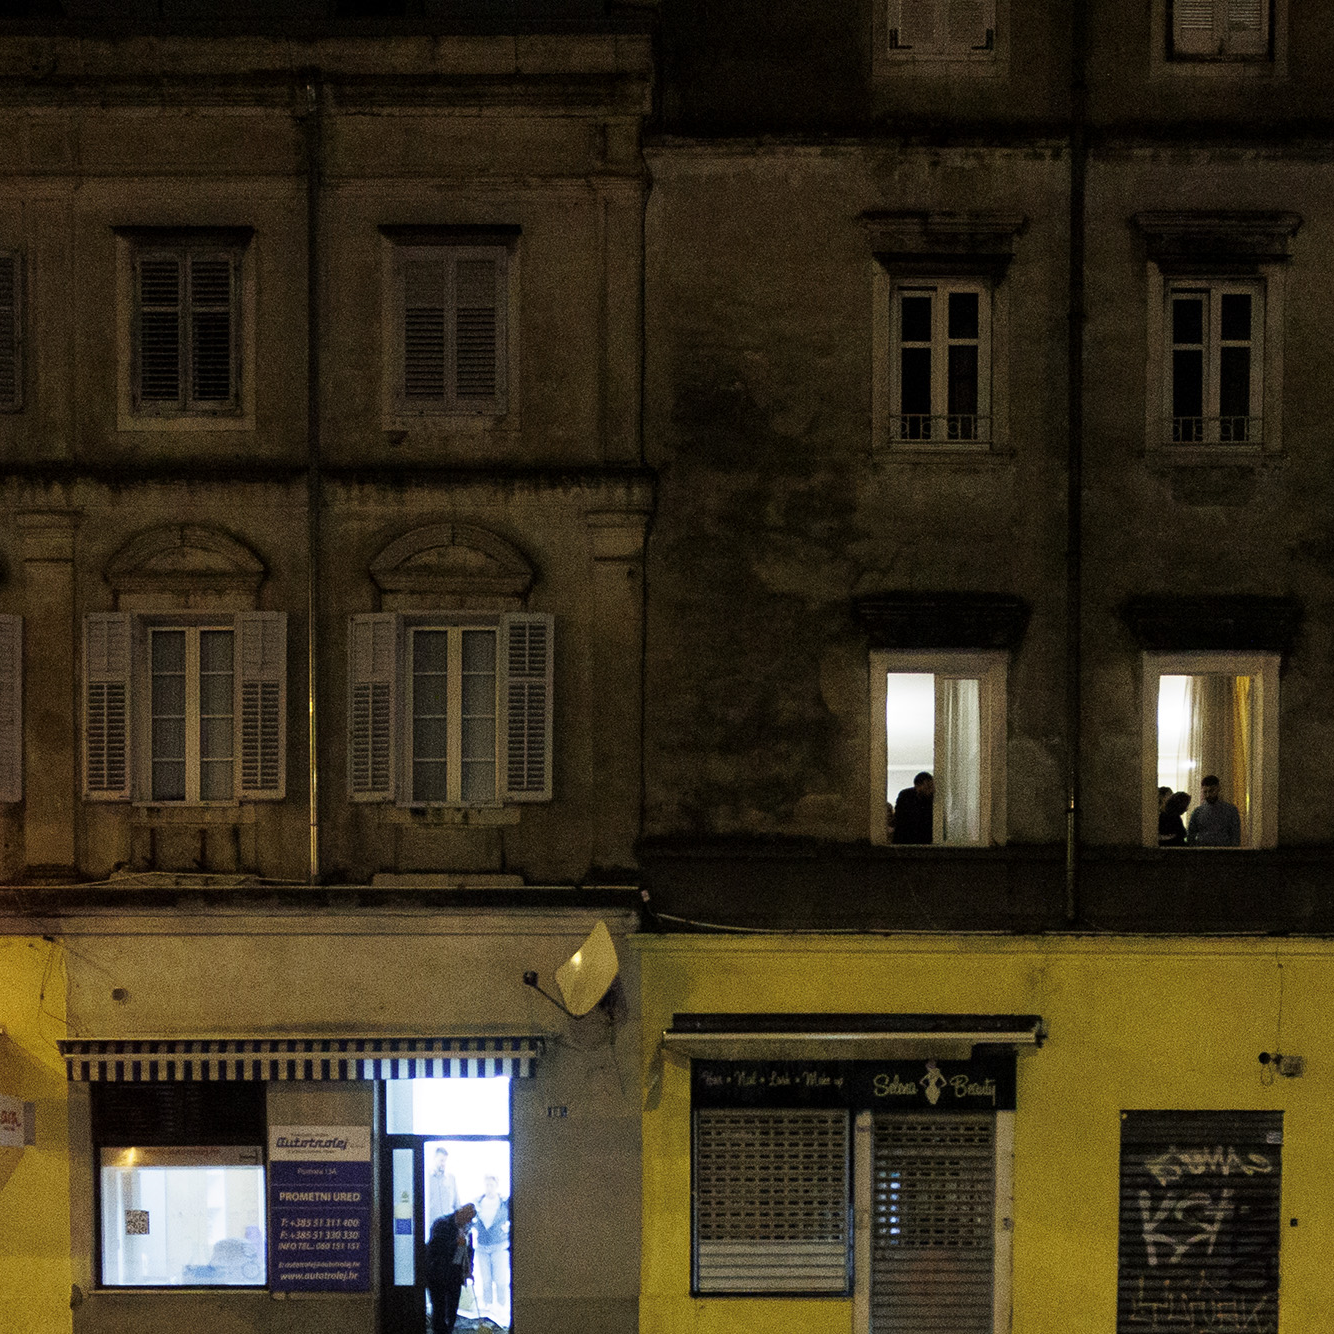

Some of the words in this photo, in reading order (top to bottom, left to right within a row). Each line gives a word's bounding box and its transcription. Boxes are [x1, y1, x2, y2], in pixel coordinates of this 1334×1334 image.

[950, 1074, 996, 1106] Beauty
[279, 1192, 331, 1201] PROMETNI
[333, 1192, 360, 1201] URED
